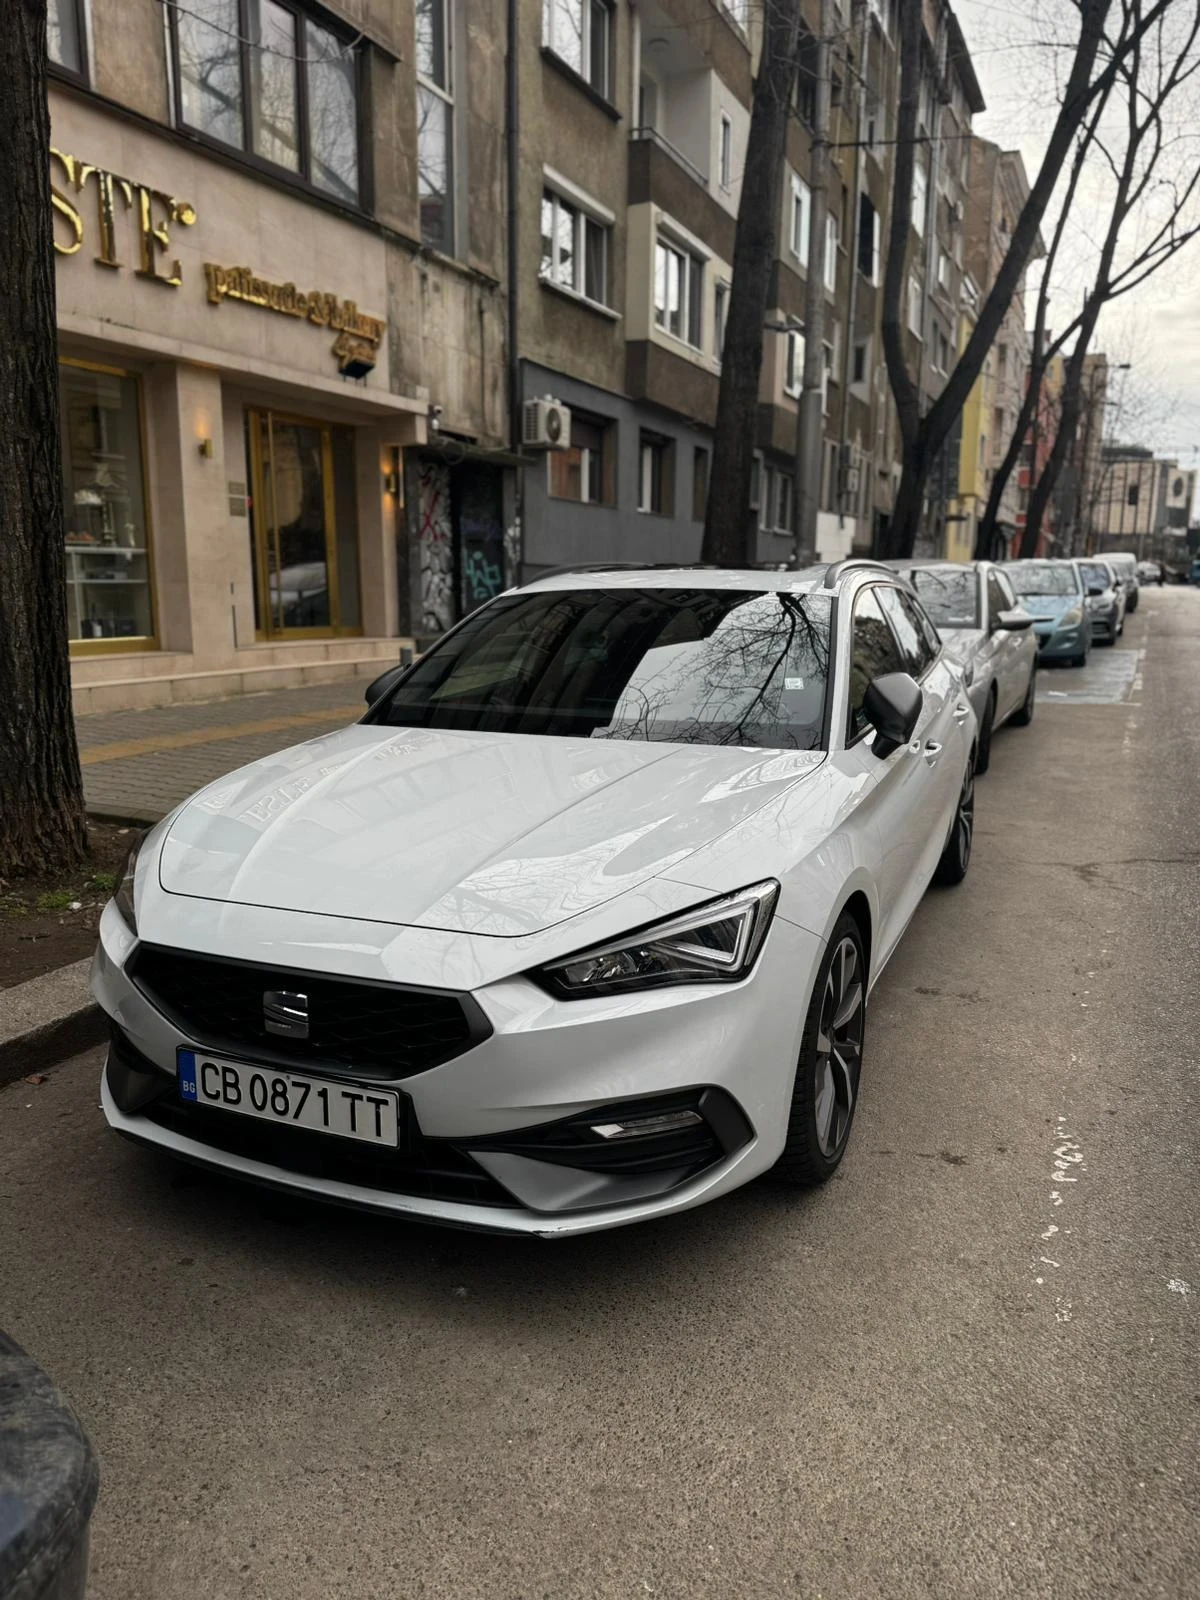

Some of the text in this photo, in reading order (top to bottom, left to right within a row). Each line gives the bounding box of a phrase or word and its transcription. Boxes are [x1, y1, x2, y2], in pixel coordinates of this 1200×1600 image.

[182, 1080, 197, 1094] BG
[200, 1062, 390, 1137] CB 0871 TT
